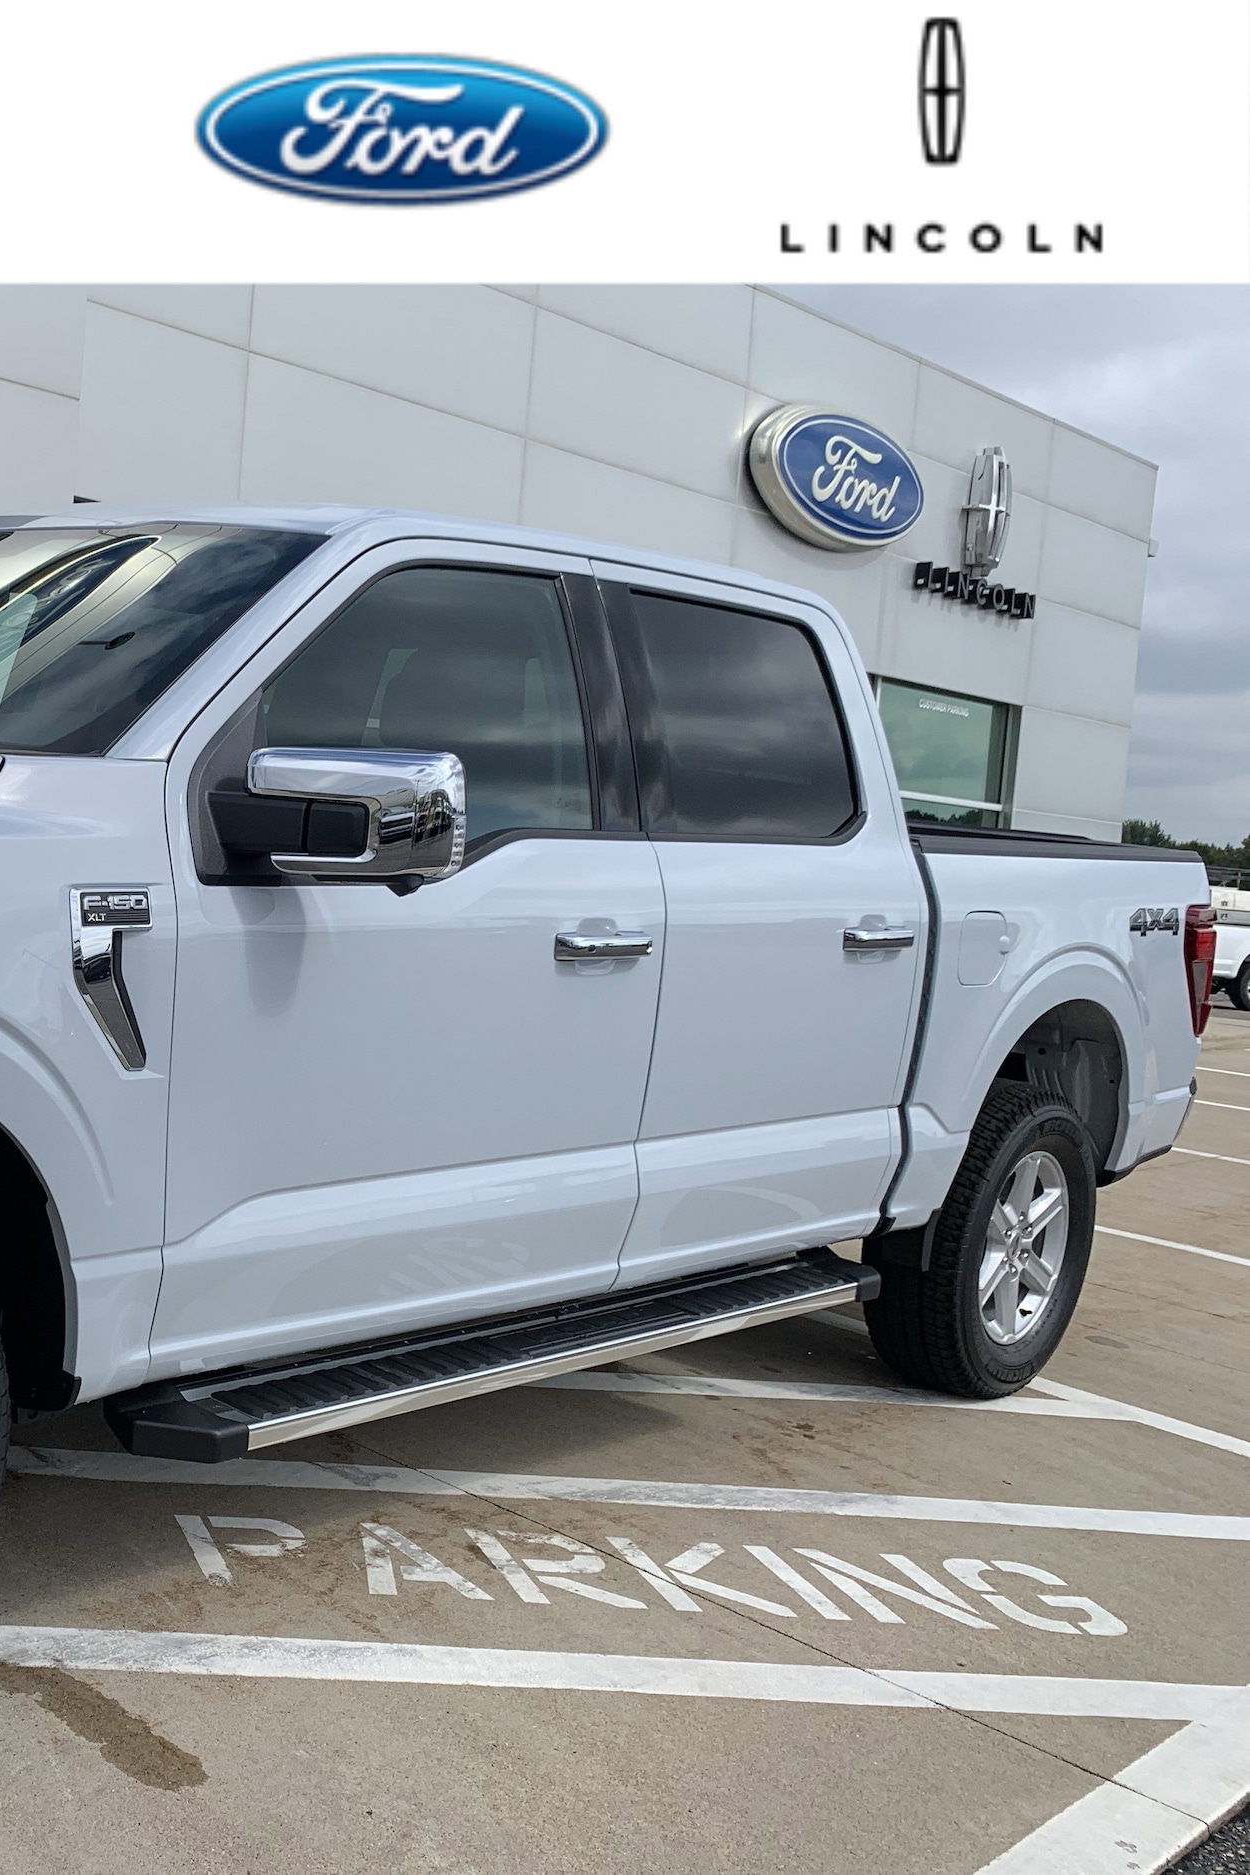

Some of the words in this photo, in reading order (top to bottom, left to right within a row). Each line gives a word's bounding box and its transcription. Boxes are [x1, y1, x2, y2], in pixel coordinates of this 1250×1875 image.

[811, 435, 901, 522] Ford
[915, 561, 1037, 619] LINCOLN
[84, 895, 148, 910] F-150
[87, 913, 107, 922] XLT
[173, 1514, 1128, 1636] PARKING
